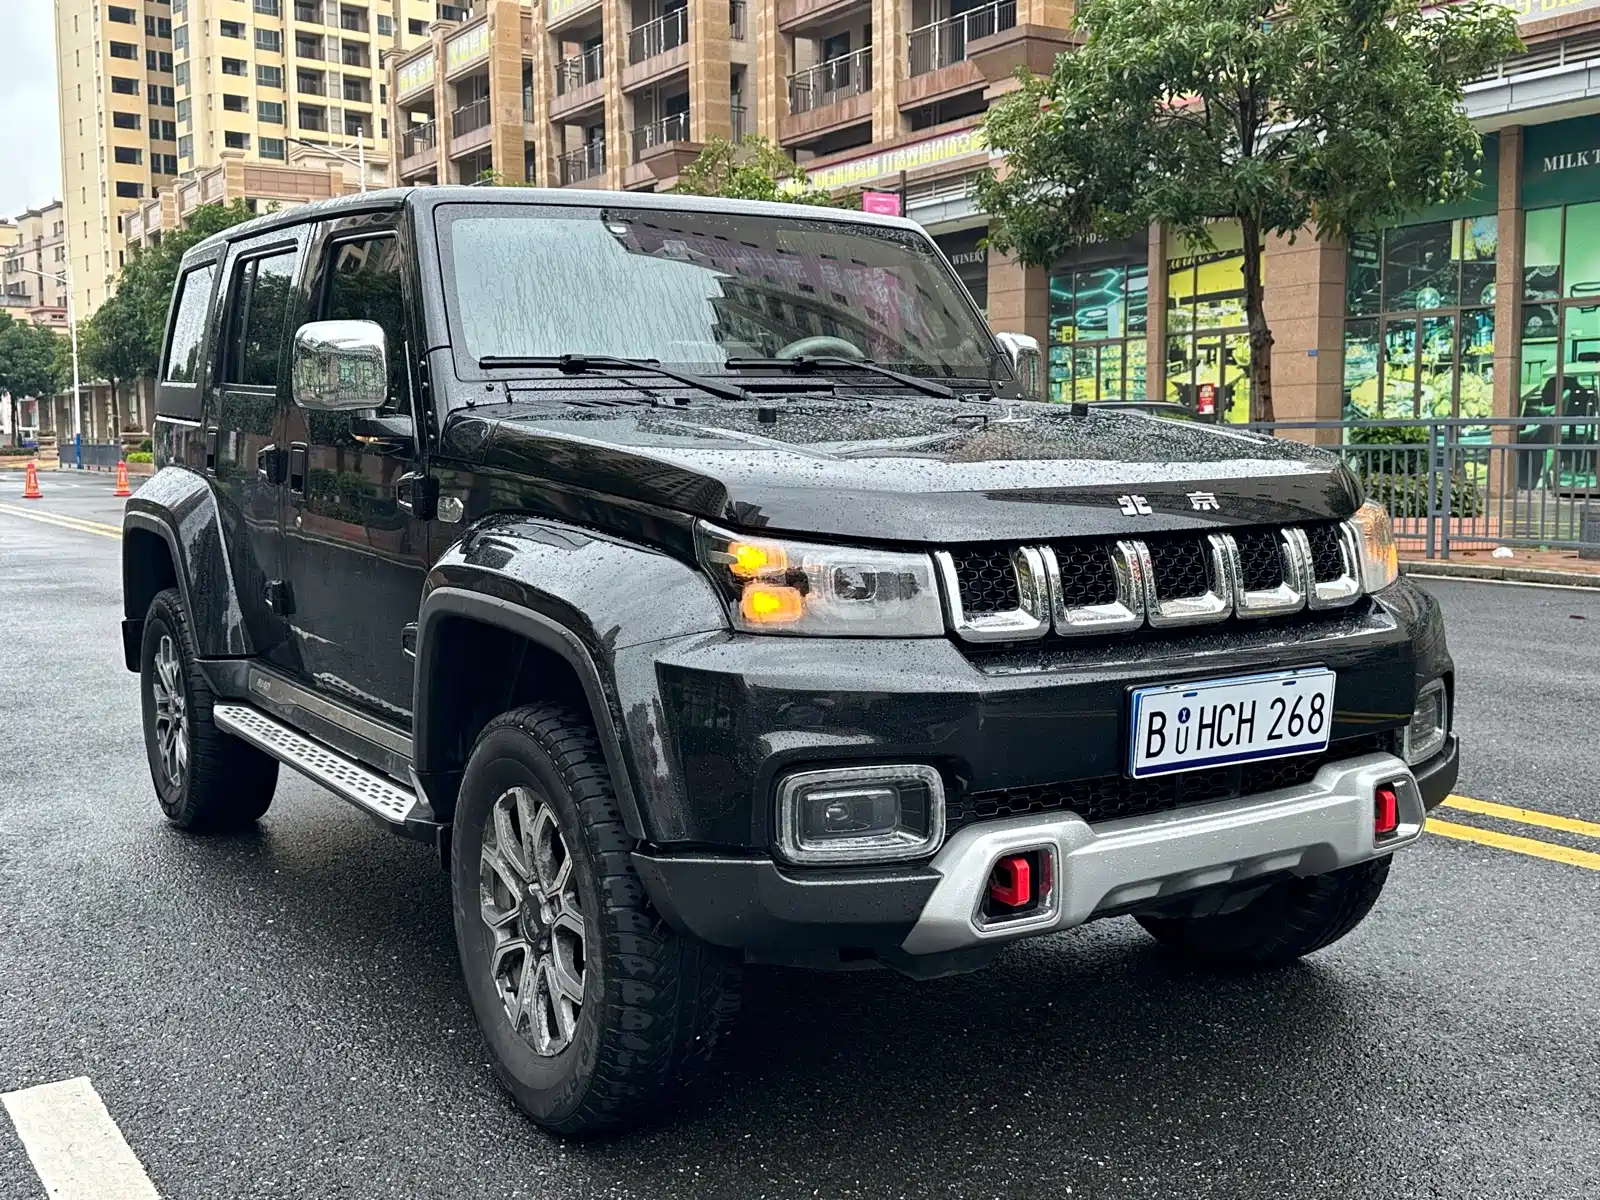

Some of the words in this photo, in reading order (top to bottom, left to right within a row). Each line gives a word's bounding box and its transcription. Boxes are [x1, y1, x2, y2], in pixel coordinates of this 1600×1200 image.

[1542, 151, 1589, 172] MILK
[1117, 491, 1220, 516] 北京
[1266, 692, 1326, 741] 268
